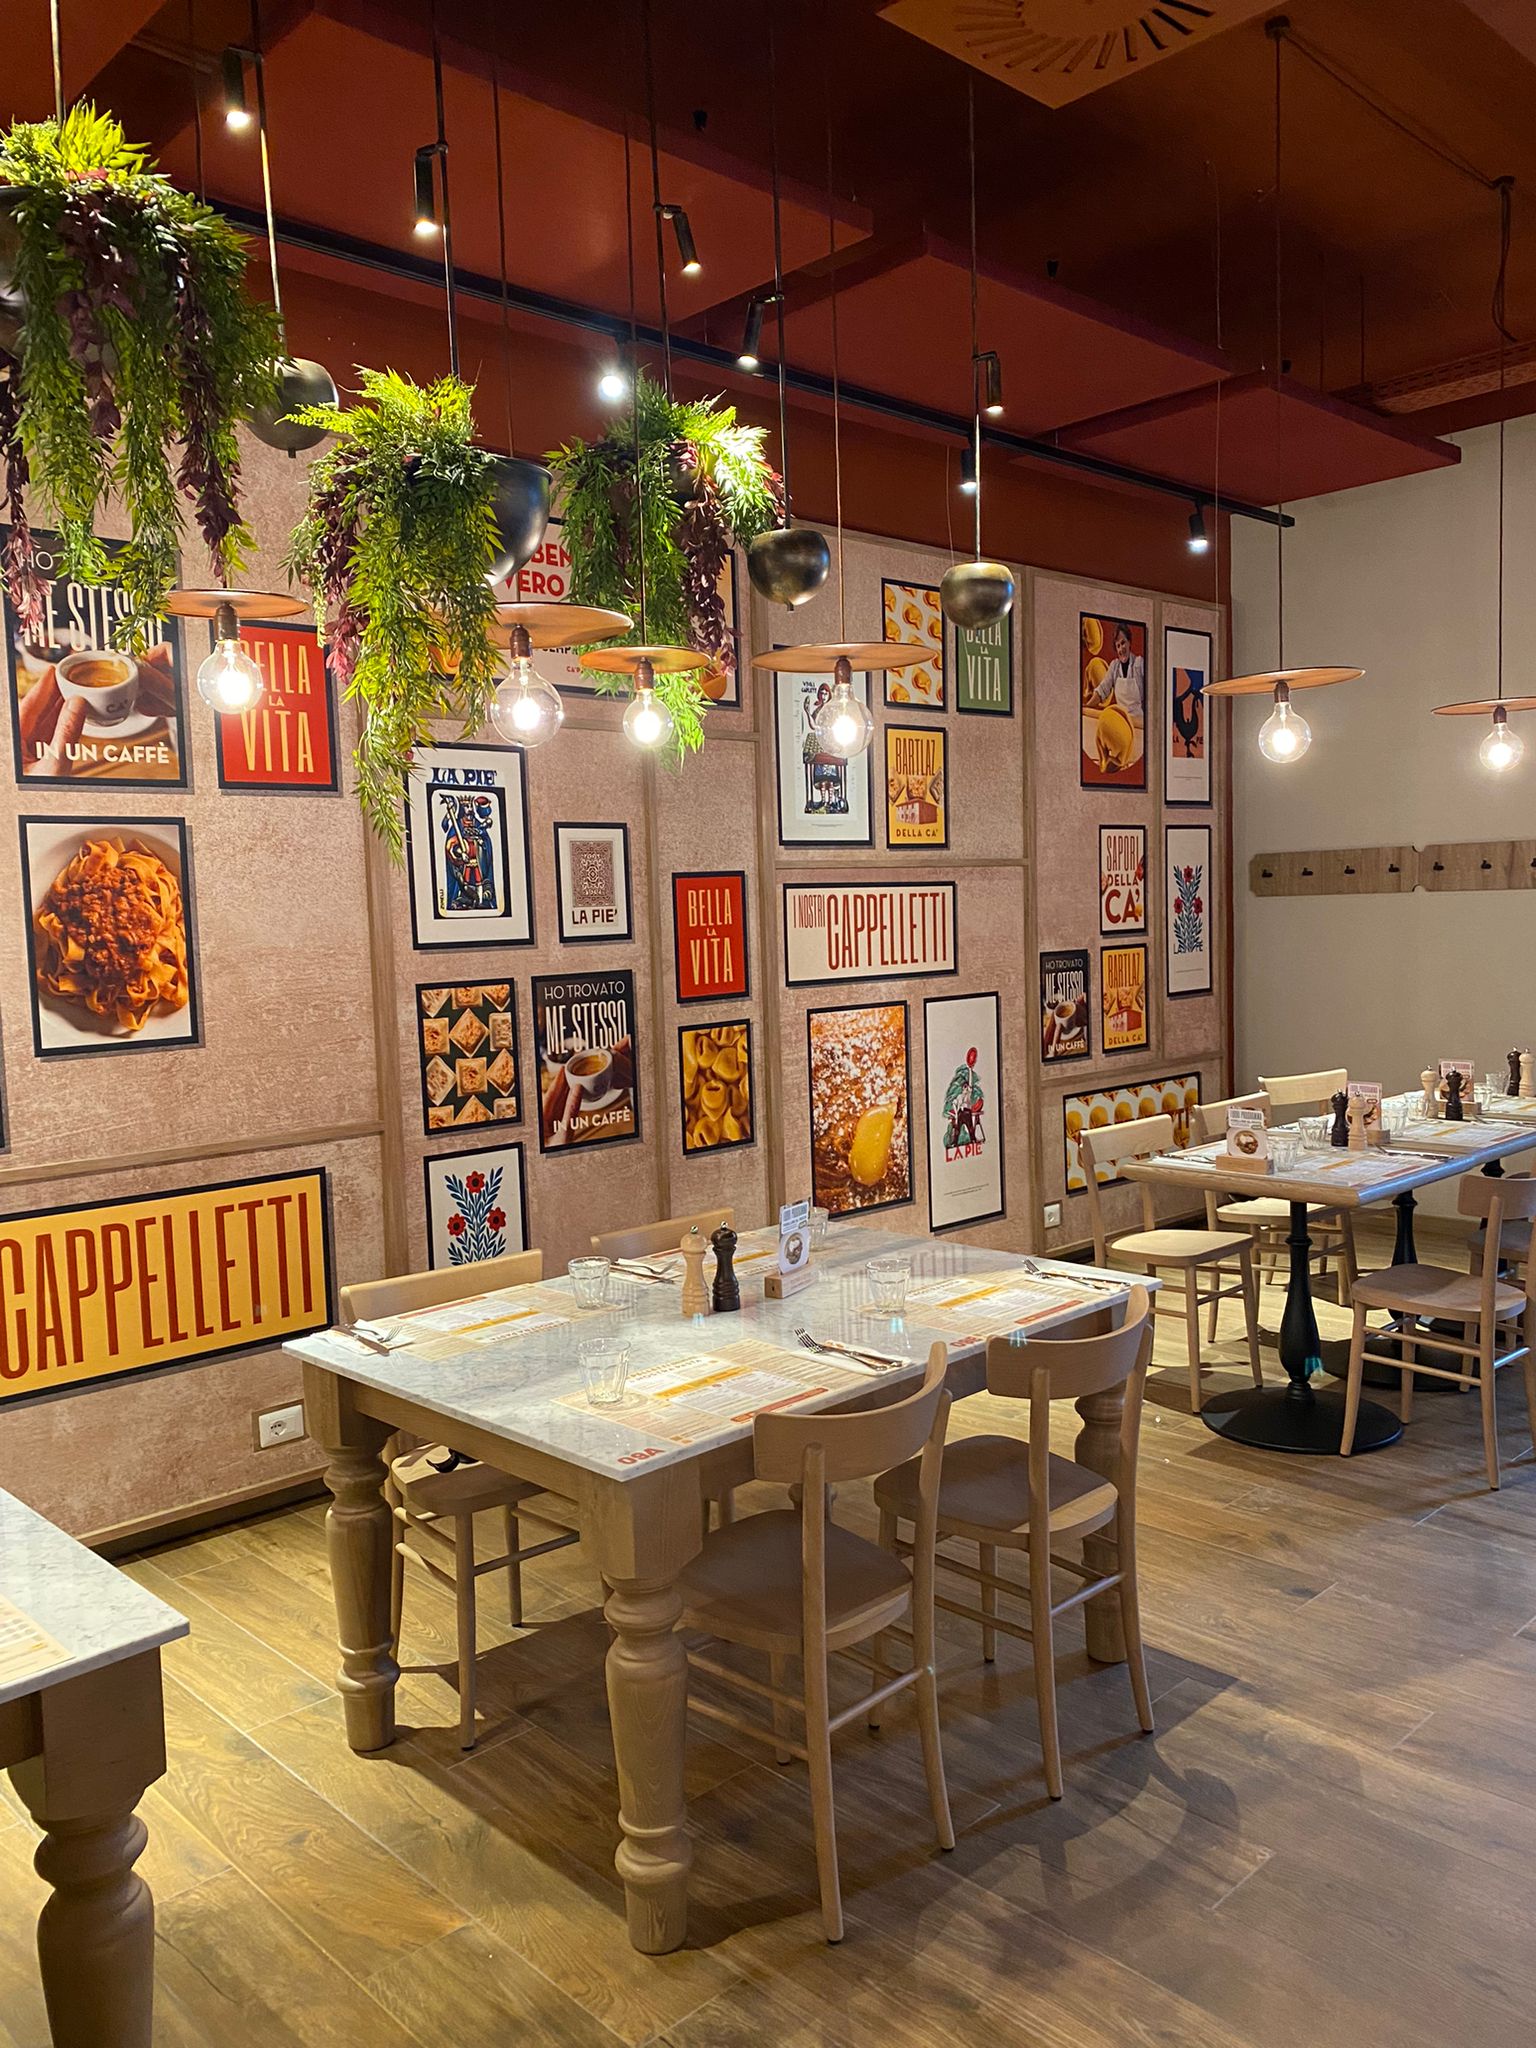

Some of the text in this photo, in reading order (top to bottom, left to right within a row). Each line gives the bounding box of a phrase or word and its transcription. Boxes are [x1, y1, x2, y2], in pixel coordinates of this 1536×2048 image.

[24, 579, 61, 649] E
[980, 646, 989, 655] LA
[240, 641, 311, 695] ELLA
[967, 655, 1002, 701] VITA
[268, 695, 285, 707] LA
[35, 741, 169, 764] IN UN CAFFÈ
[240, 706, 314, 773] VITA
[895, 737, 936, 776] BARTLAZ
[431, 767, 459, 785] LA
[896, 828, 939, 837] DELLA CA'
[1106, 835, 1139, 871] SAPORI
[1107, 873, 1139, 887] DELLA
[572, 908, 618, 924] LA PIE'
[687, 888, 733, 927] BELLA
[1105, 888, 1140, 924] CA'
[706, 927, 717, 936] LA
[798, 894, 826, 928] NOSTRI
[826, 892, 947, 970] CAPPELLETTI
[690, 937, 734, 985] VITA
[1045, 958, 1084, 970] HO TROVATO
[1107, 952, 1141, 989] BARTLAZ
[544, 980, 625, 1000] HO TROVATO
[1045, 970, 1084, 1003] ME STESSO
[545, 999, 628, 1056] ME STESSO
[1108, 1036, 1130, 1046] DELLA
[1055, 1042, 1065, 1052] UN
[1065, 1038, 1085, 1051] CAFFÈ
[553, 1106, 631, 1133] IN UN CAFFÈ
[945, 1146, 964, 1163] LA
[0, 1191, 313, 1380] CAPPELLETTI
